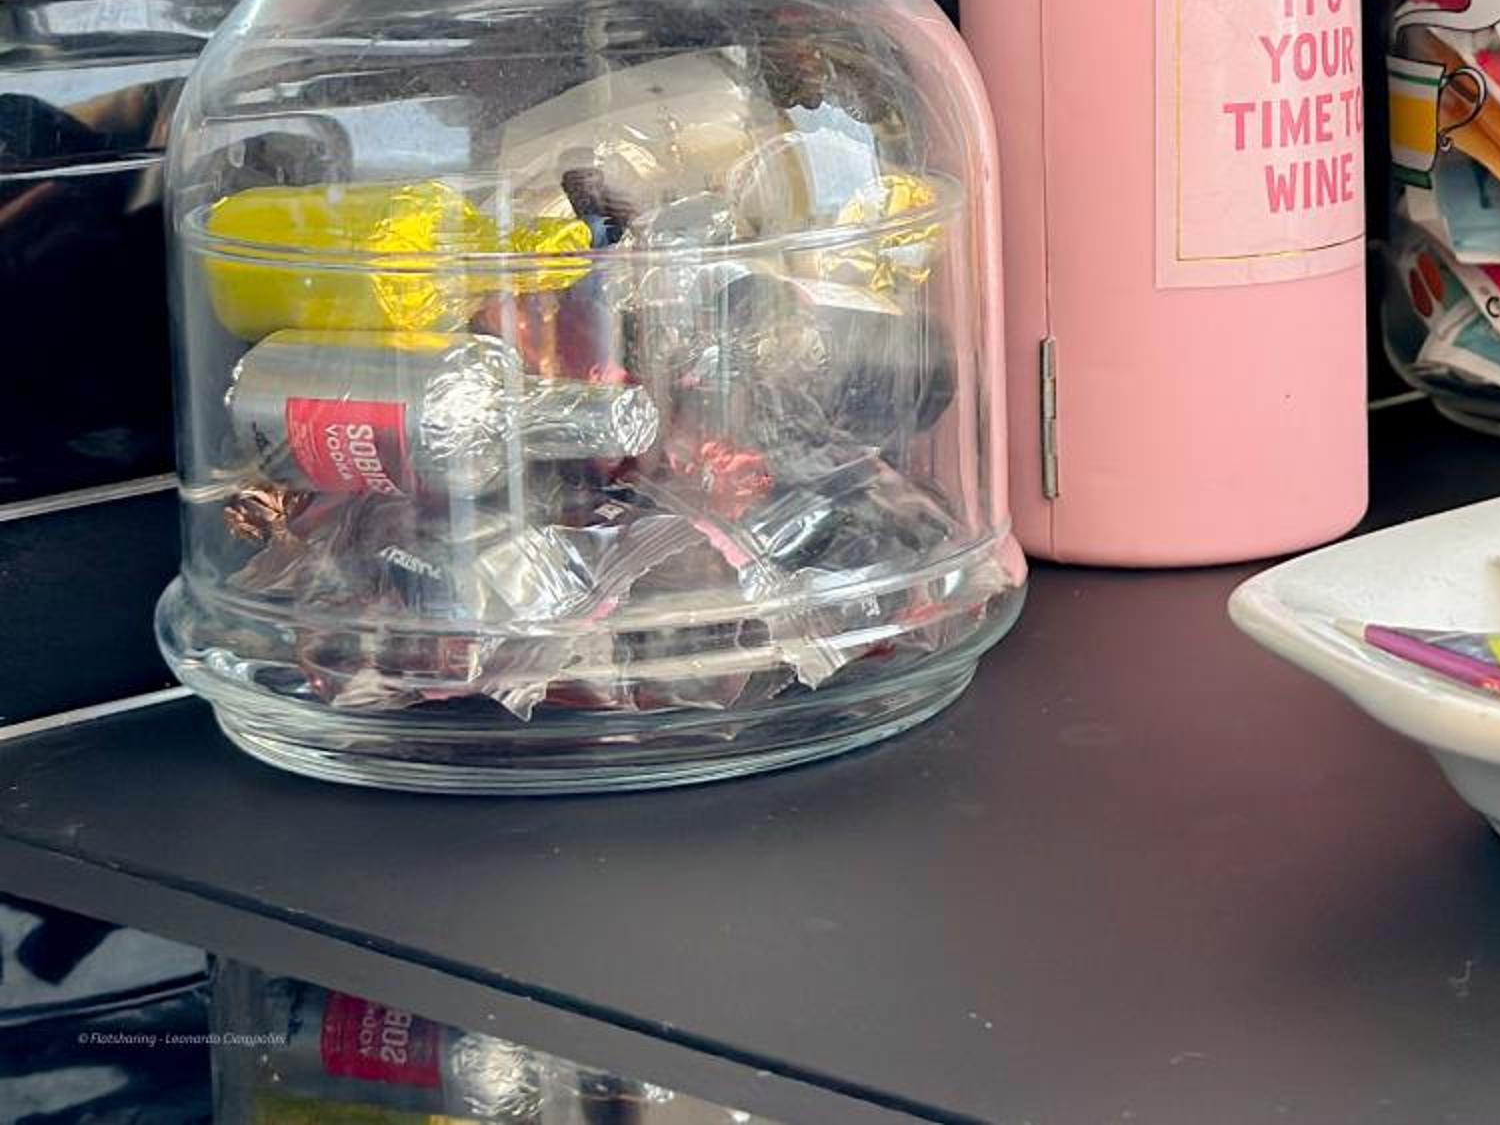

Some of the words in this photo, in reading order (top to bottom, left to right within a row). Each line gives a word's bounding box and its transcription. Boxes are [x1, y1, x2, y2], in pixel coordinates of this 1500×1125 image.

[1259, 26, 1354, 84] YOUR
[1223, 93, 1333, 151] TIME
[1265, 154, 1353, 213] WINE
